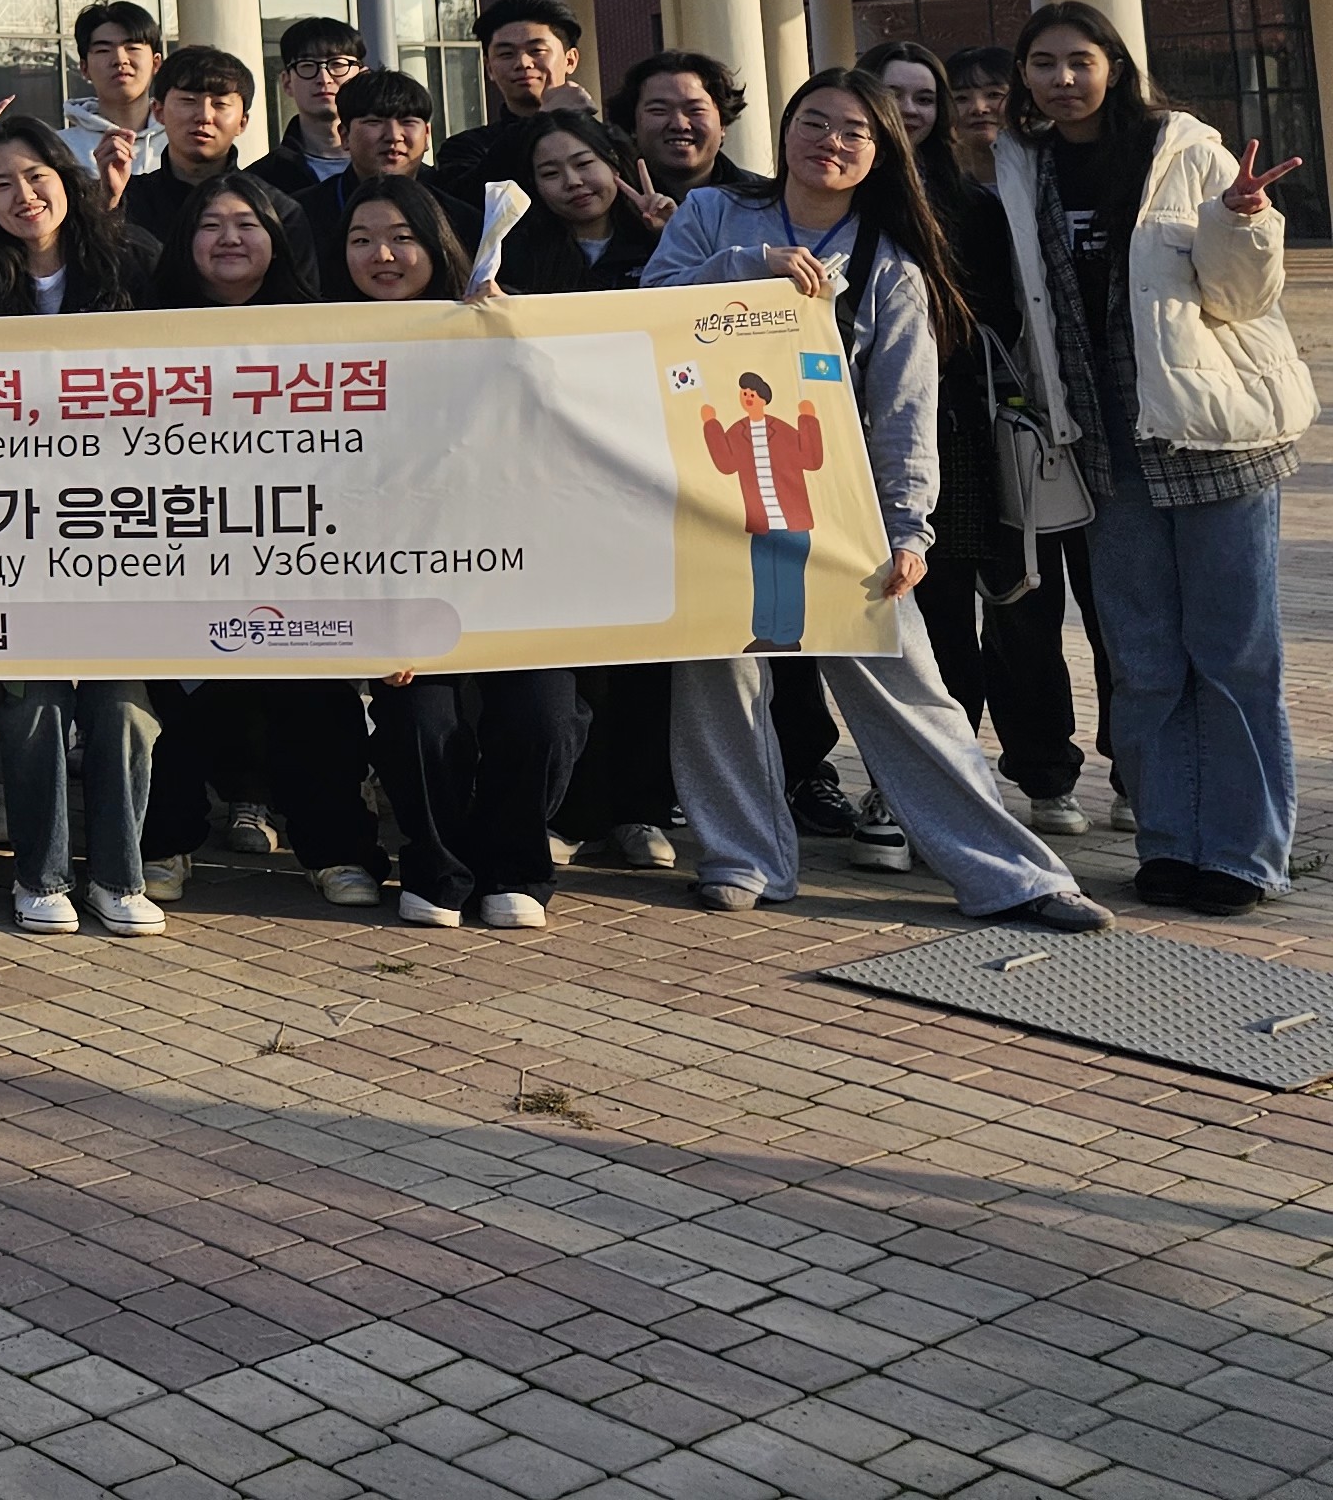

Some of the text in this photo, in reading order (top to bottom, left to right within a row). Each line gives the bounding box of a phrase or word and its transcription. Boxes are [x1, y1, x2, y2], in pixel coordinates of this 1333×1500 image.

[694, 309, 798, 336] 재외동포협력센터
[58, 365, 213, 421] 문화적
[232, 359, 387, 415] 구심점
[121, 422, 363, 457] Узбекистана
[55, 484, 337, 540] 응원합니다.
[48, 542, 185, 587] Кореей
[210, 552, 230, 576] и
[252, 541, 523, 576] Узбекистаном
[208, 618, 354, 645] 재외동포협력센터
